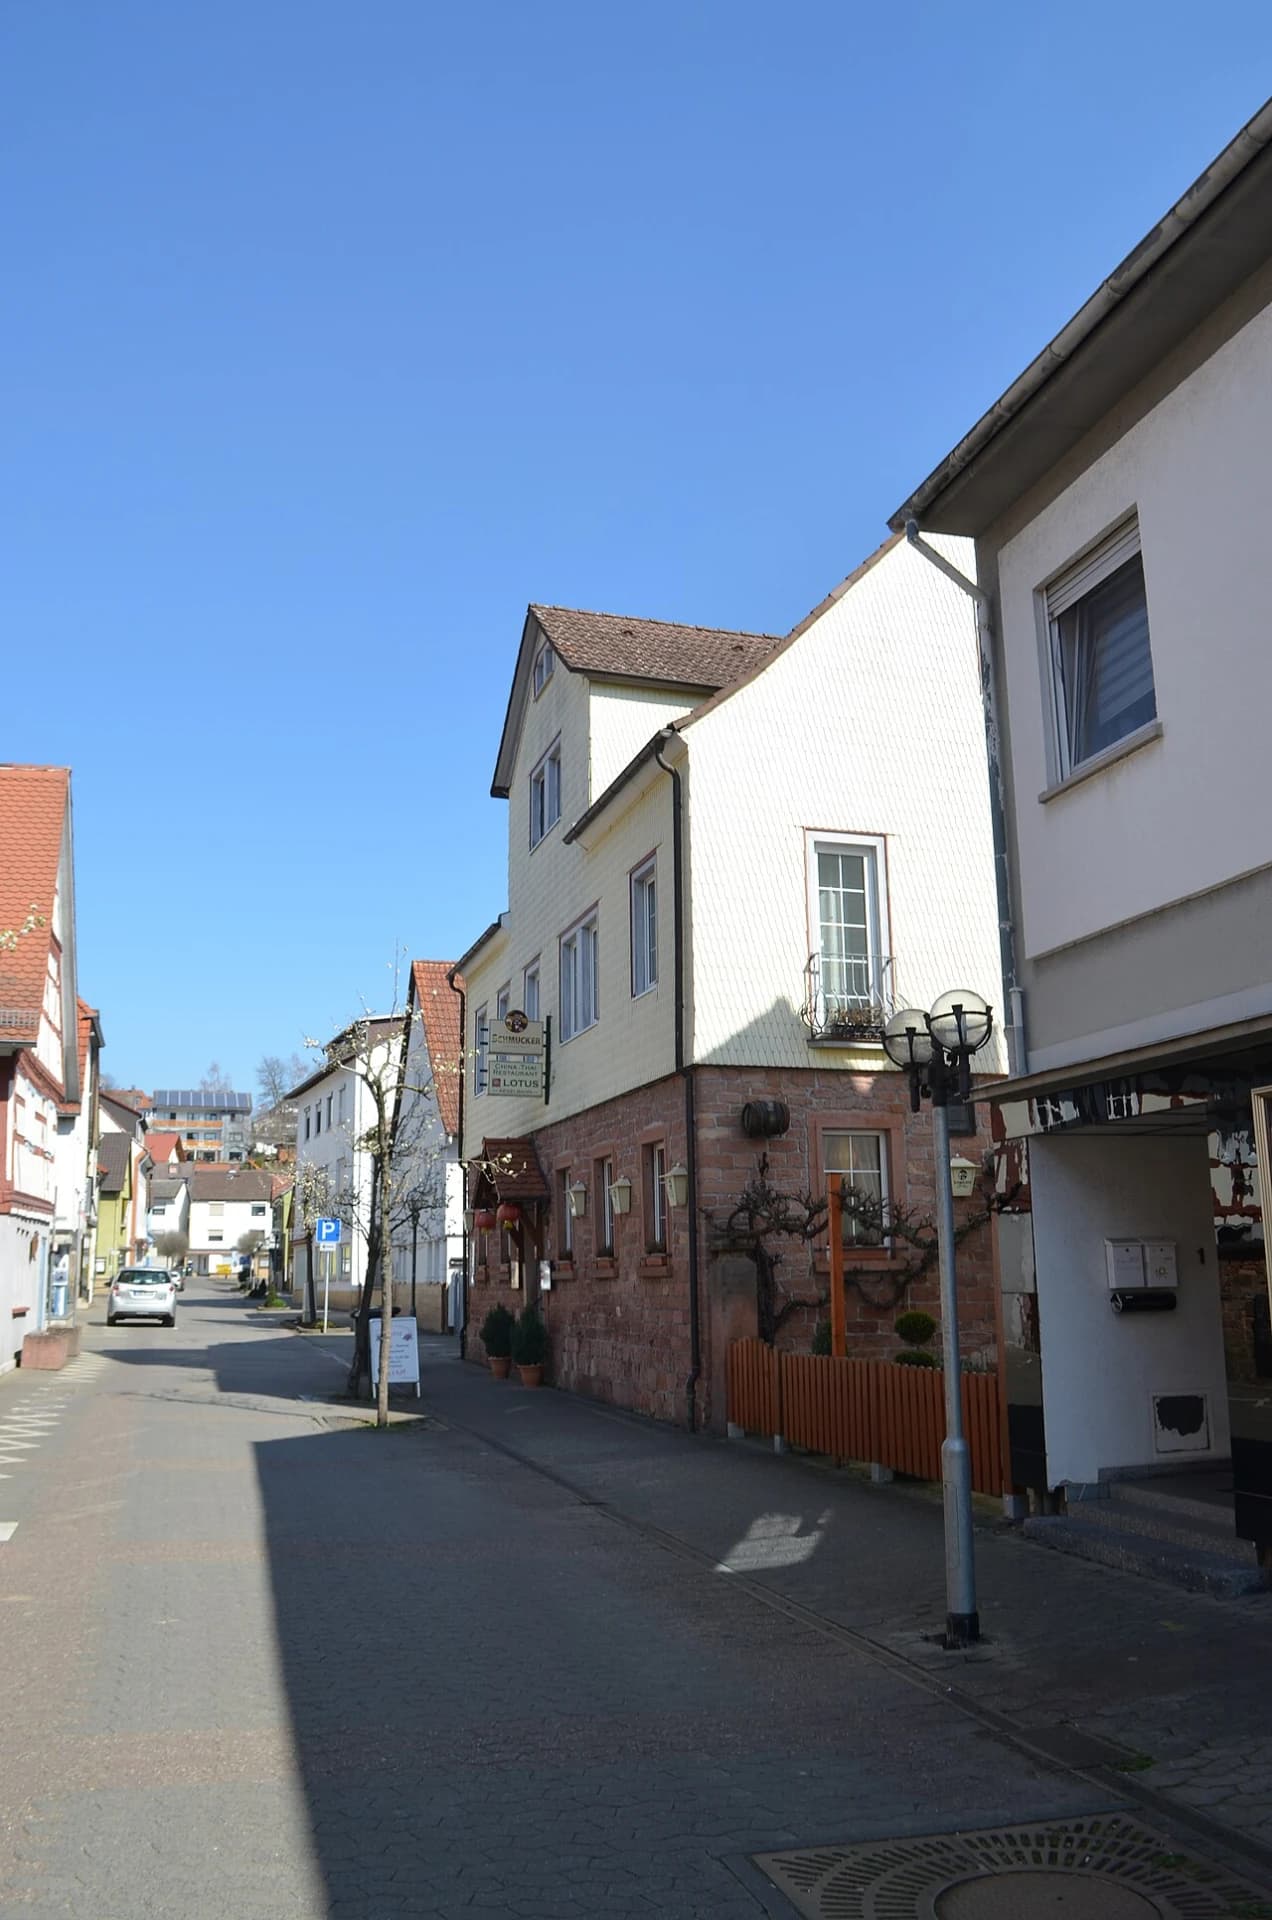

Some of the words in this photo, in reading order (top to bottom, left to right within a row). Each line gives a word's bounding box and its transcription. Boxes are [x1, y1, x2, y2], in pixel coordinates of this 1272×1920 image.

[492, 1033, 541, 1045] SCHMUCKER
[503, 1079, 539, 1088] LOTUS
[322, 1221, 335, 1240] P
